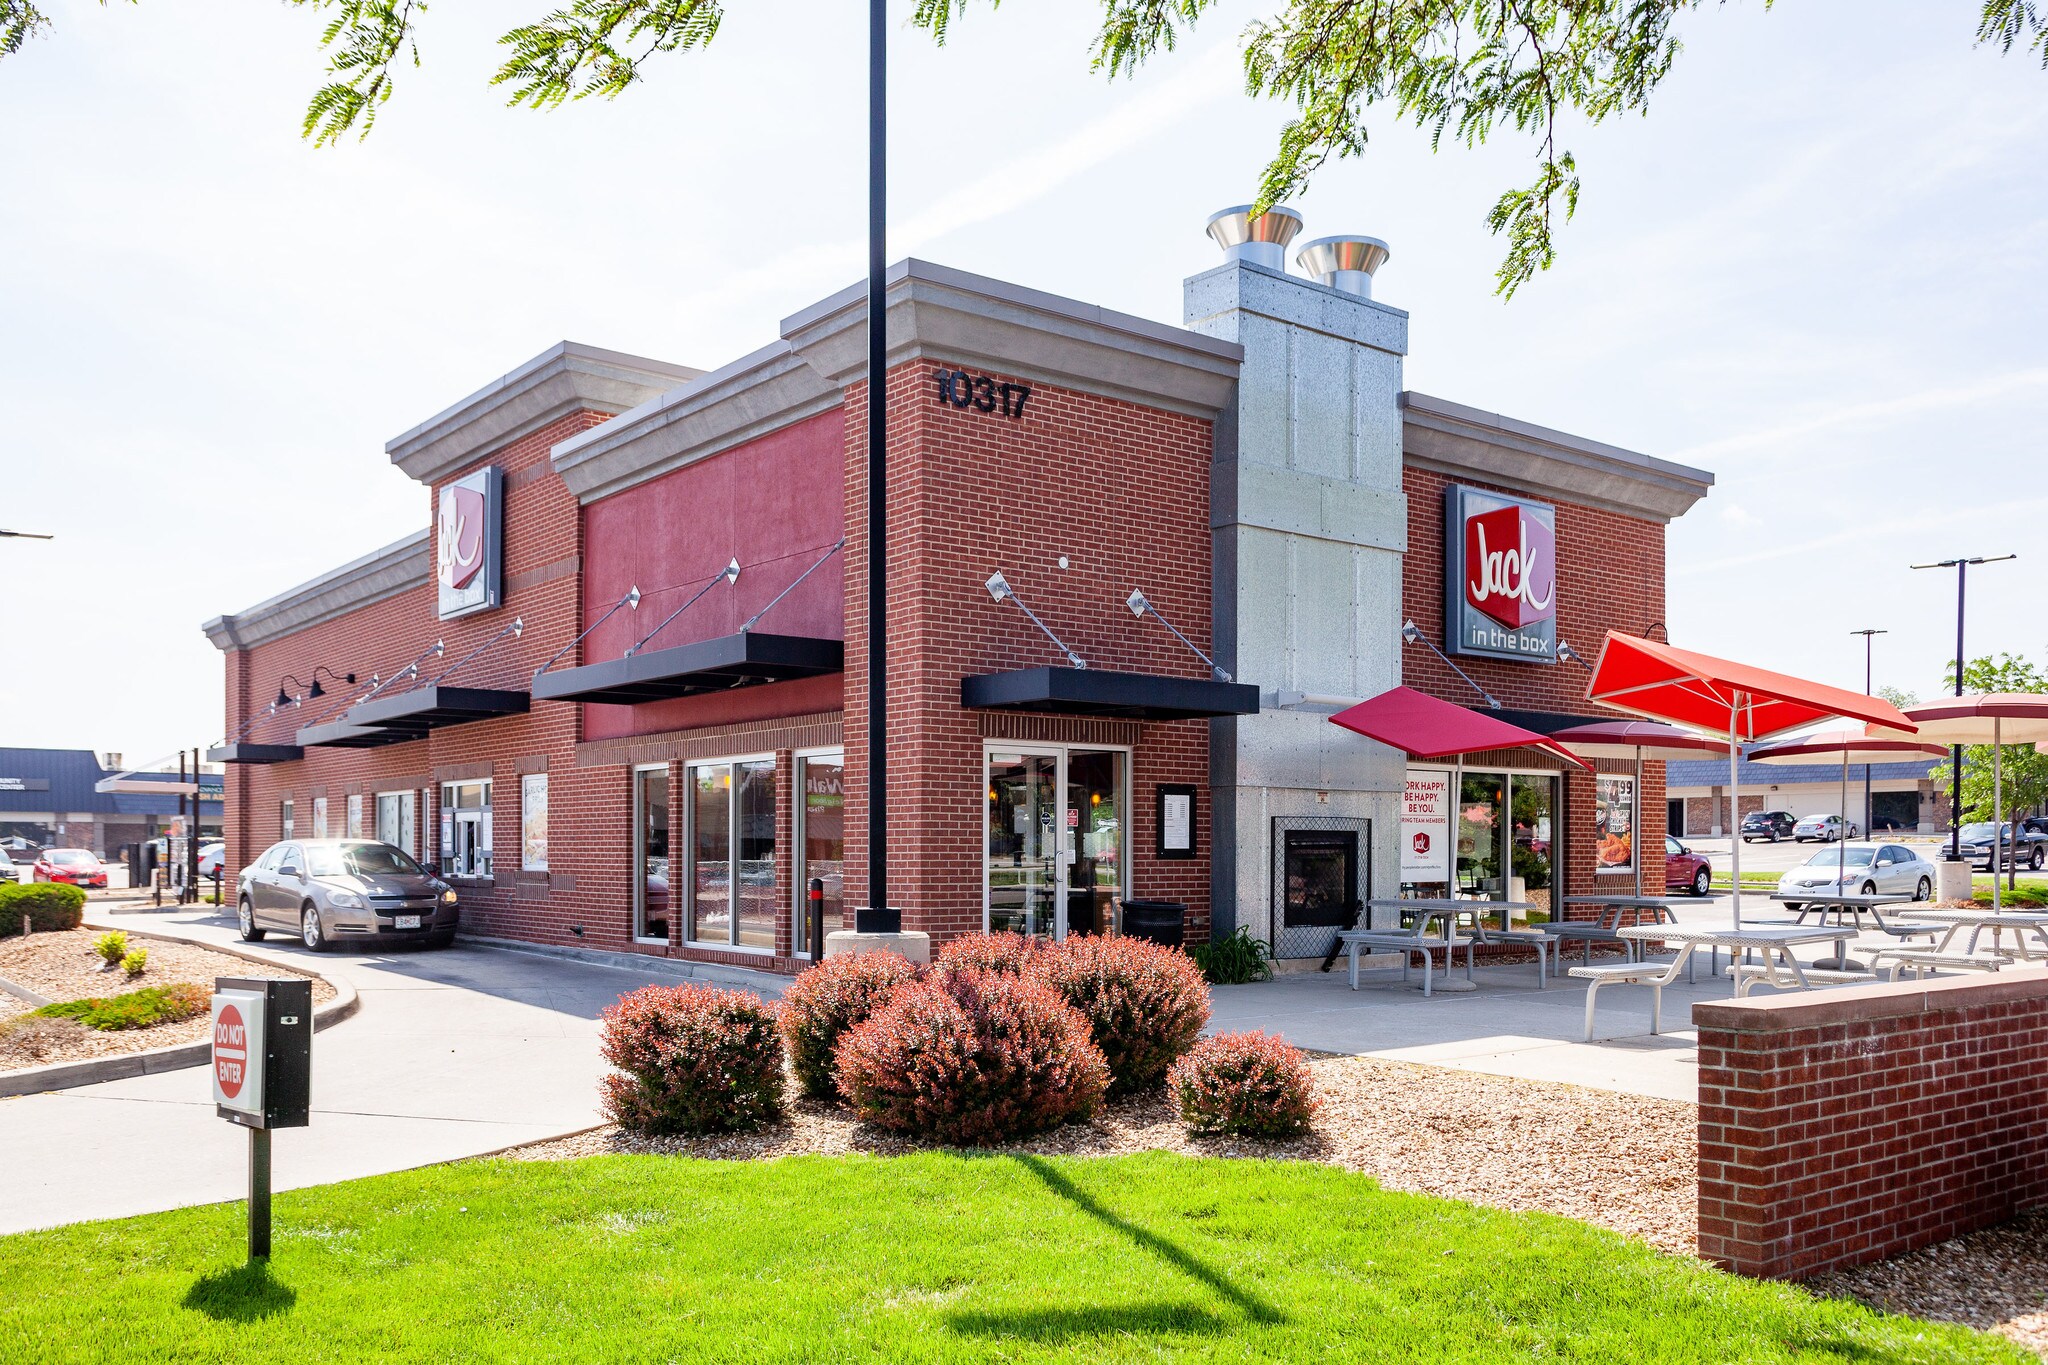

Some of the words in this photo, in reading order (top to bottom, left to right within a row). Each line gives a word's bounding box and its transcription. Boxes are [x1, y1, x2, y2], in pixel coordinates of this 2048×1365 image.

[931, 368, 1031, 419] 10317
[1471, 520, 1554, 611] Jack
[1472, 625, 1487, 646] in
[1491, 628, 1517, 650] the
[1520, 632, 1549, 653] box
[1404, 792, 1413, 801] BE
[1414, 793, 1439, 802] HAPPY.
[1406, 781, 1420, 791] ORK
[1421, 782, 1446, 791] HAPPY.
[1408, 804, 1417, 812] BE
[1418, 804, 1435, 813] YOU.
[217, 1023, 228, 1043] DO
[229, 1025, 244, 1046] NOT
[219, 1061, 242, 1084] ENTER
